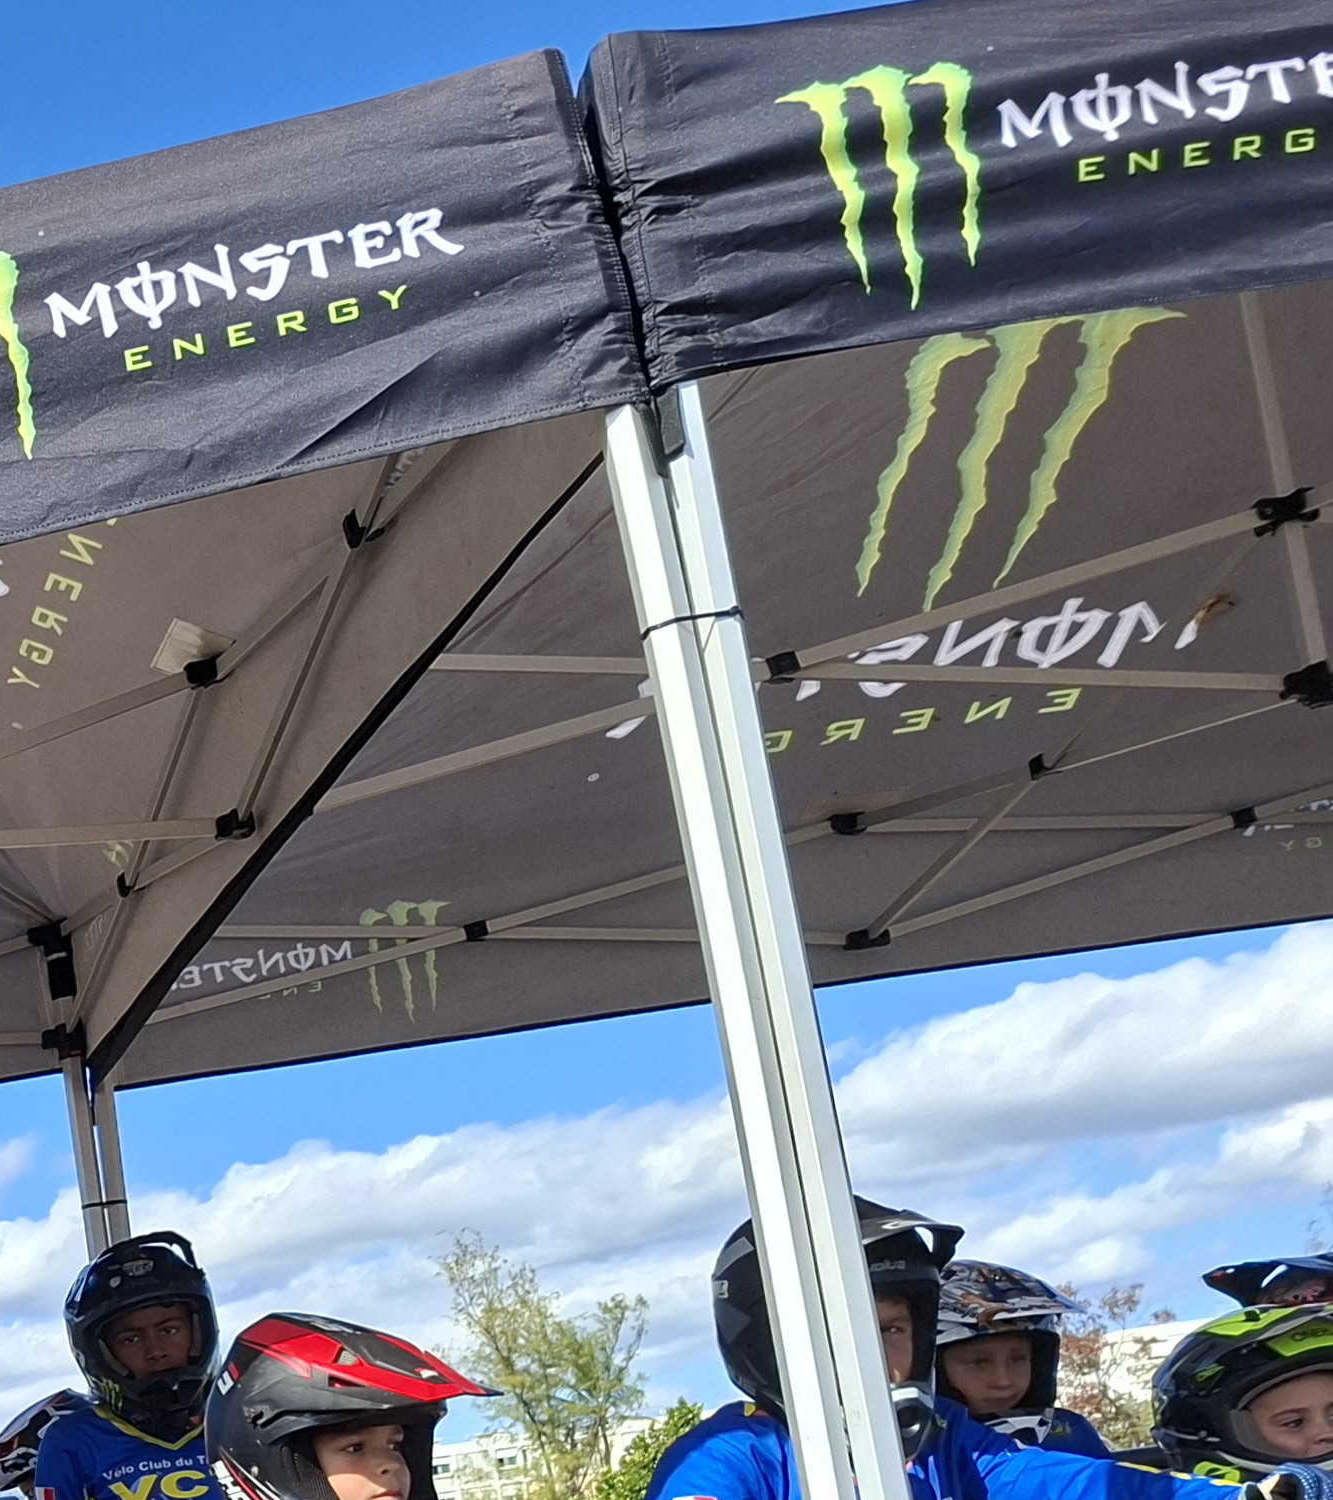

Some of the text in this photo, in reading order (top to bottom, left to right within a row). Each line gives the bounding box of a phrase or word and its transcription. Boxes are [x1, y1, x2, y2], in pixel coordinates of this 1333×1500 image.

[44, 206, 465, 339] MONSTER
[124, 284, 409, 372] ENERGY
[139, 1459, 171, 1472] Club
